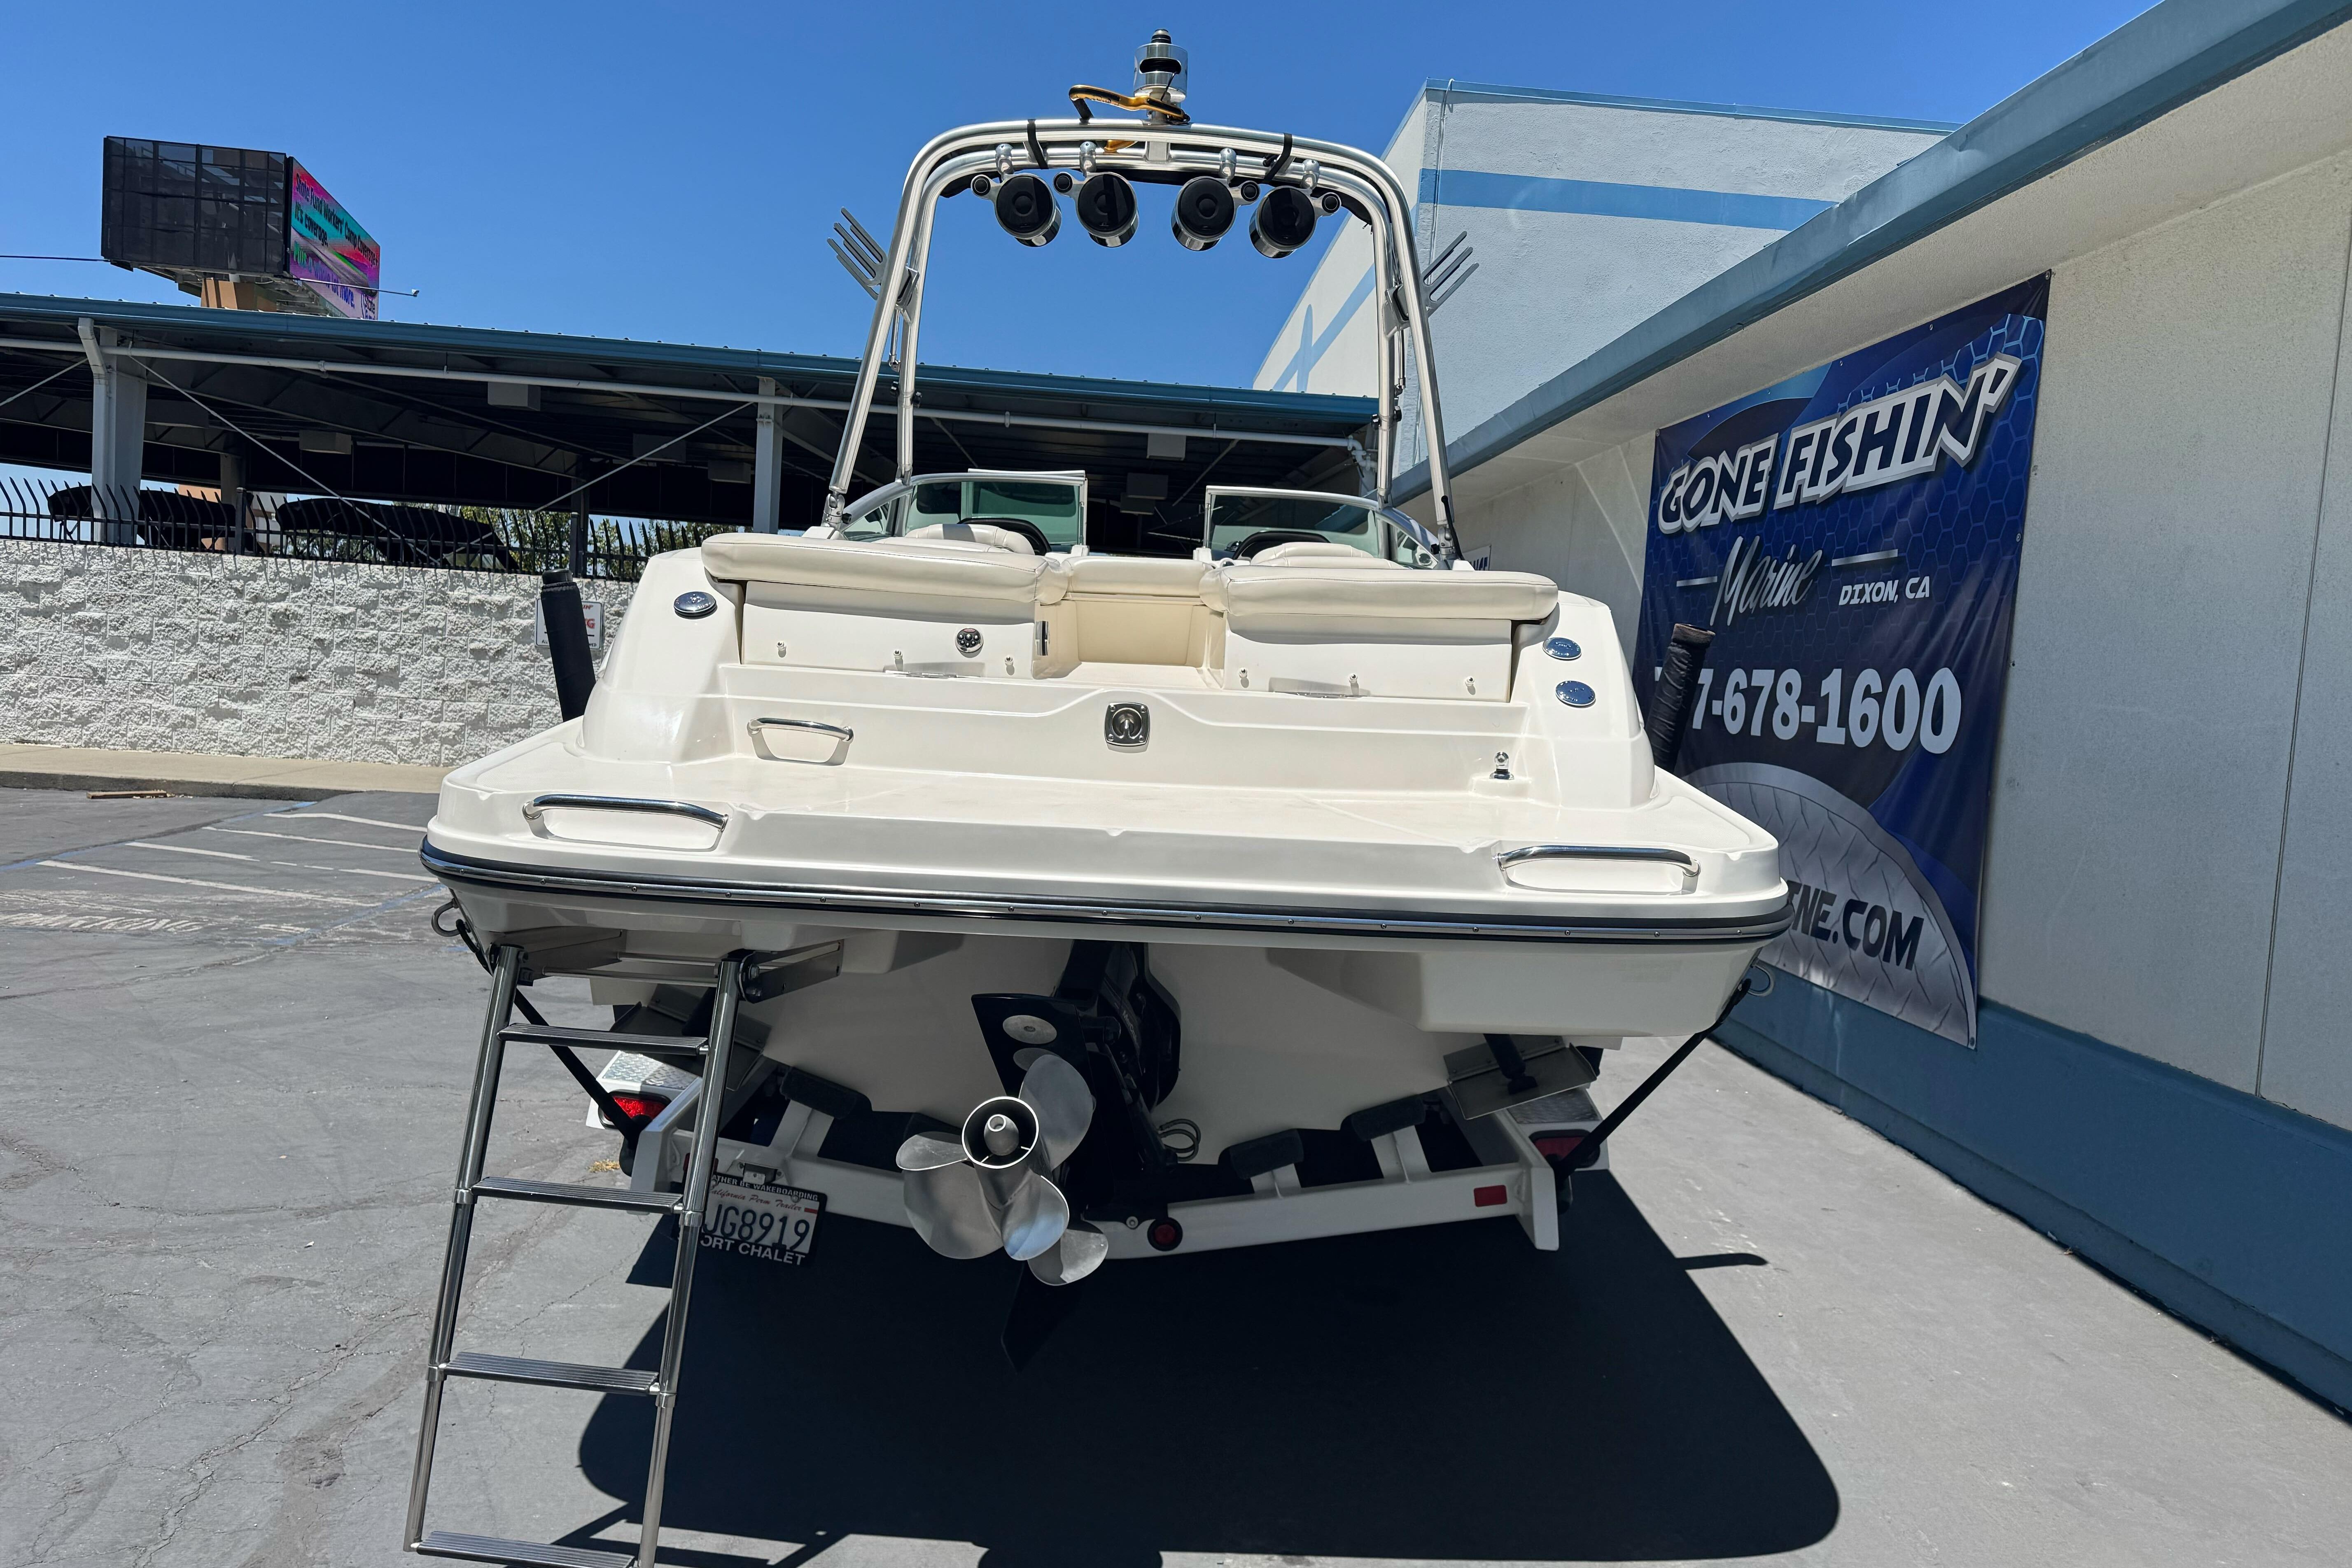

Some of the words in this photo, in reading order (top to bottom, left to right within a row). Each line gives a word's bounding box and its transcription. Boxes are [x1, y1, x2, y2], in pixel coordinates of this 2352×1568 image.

[295, 200, 303, 224] It's
[296, 173, 309, 202] State
[310, 186, 323, 215] Fund
[345, 221, 357, 251] Comp
[1658, 432, 1779, 535] GONE
[1710, 535, 1823, 626] Marine
[1839, 579, 1899, 606] DIXON,
[1905, 576, 1930, 599] CA
[1654, 667, 1961, 754] 7-678-1600
[713, 1174, 737, 1185] ATHER
[753, 1183, 818, 1201] WAKEBOARDING
[749, 1195, 771, 1204] Perm
[775, 1199, 802, 1211] Trailer
[702, 1204, 810, 1252] JG8919
[700, 1235, 735, 1251] ORT
[738, 1242, 805, 1266] CHALET
